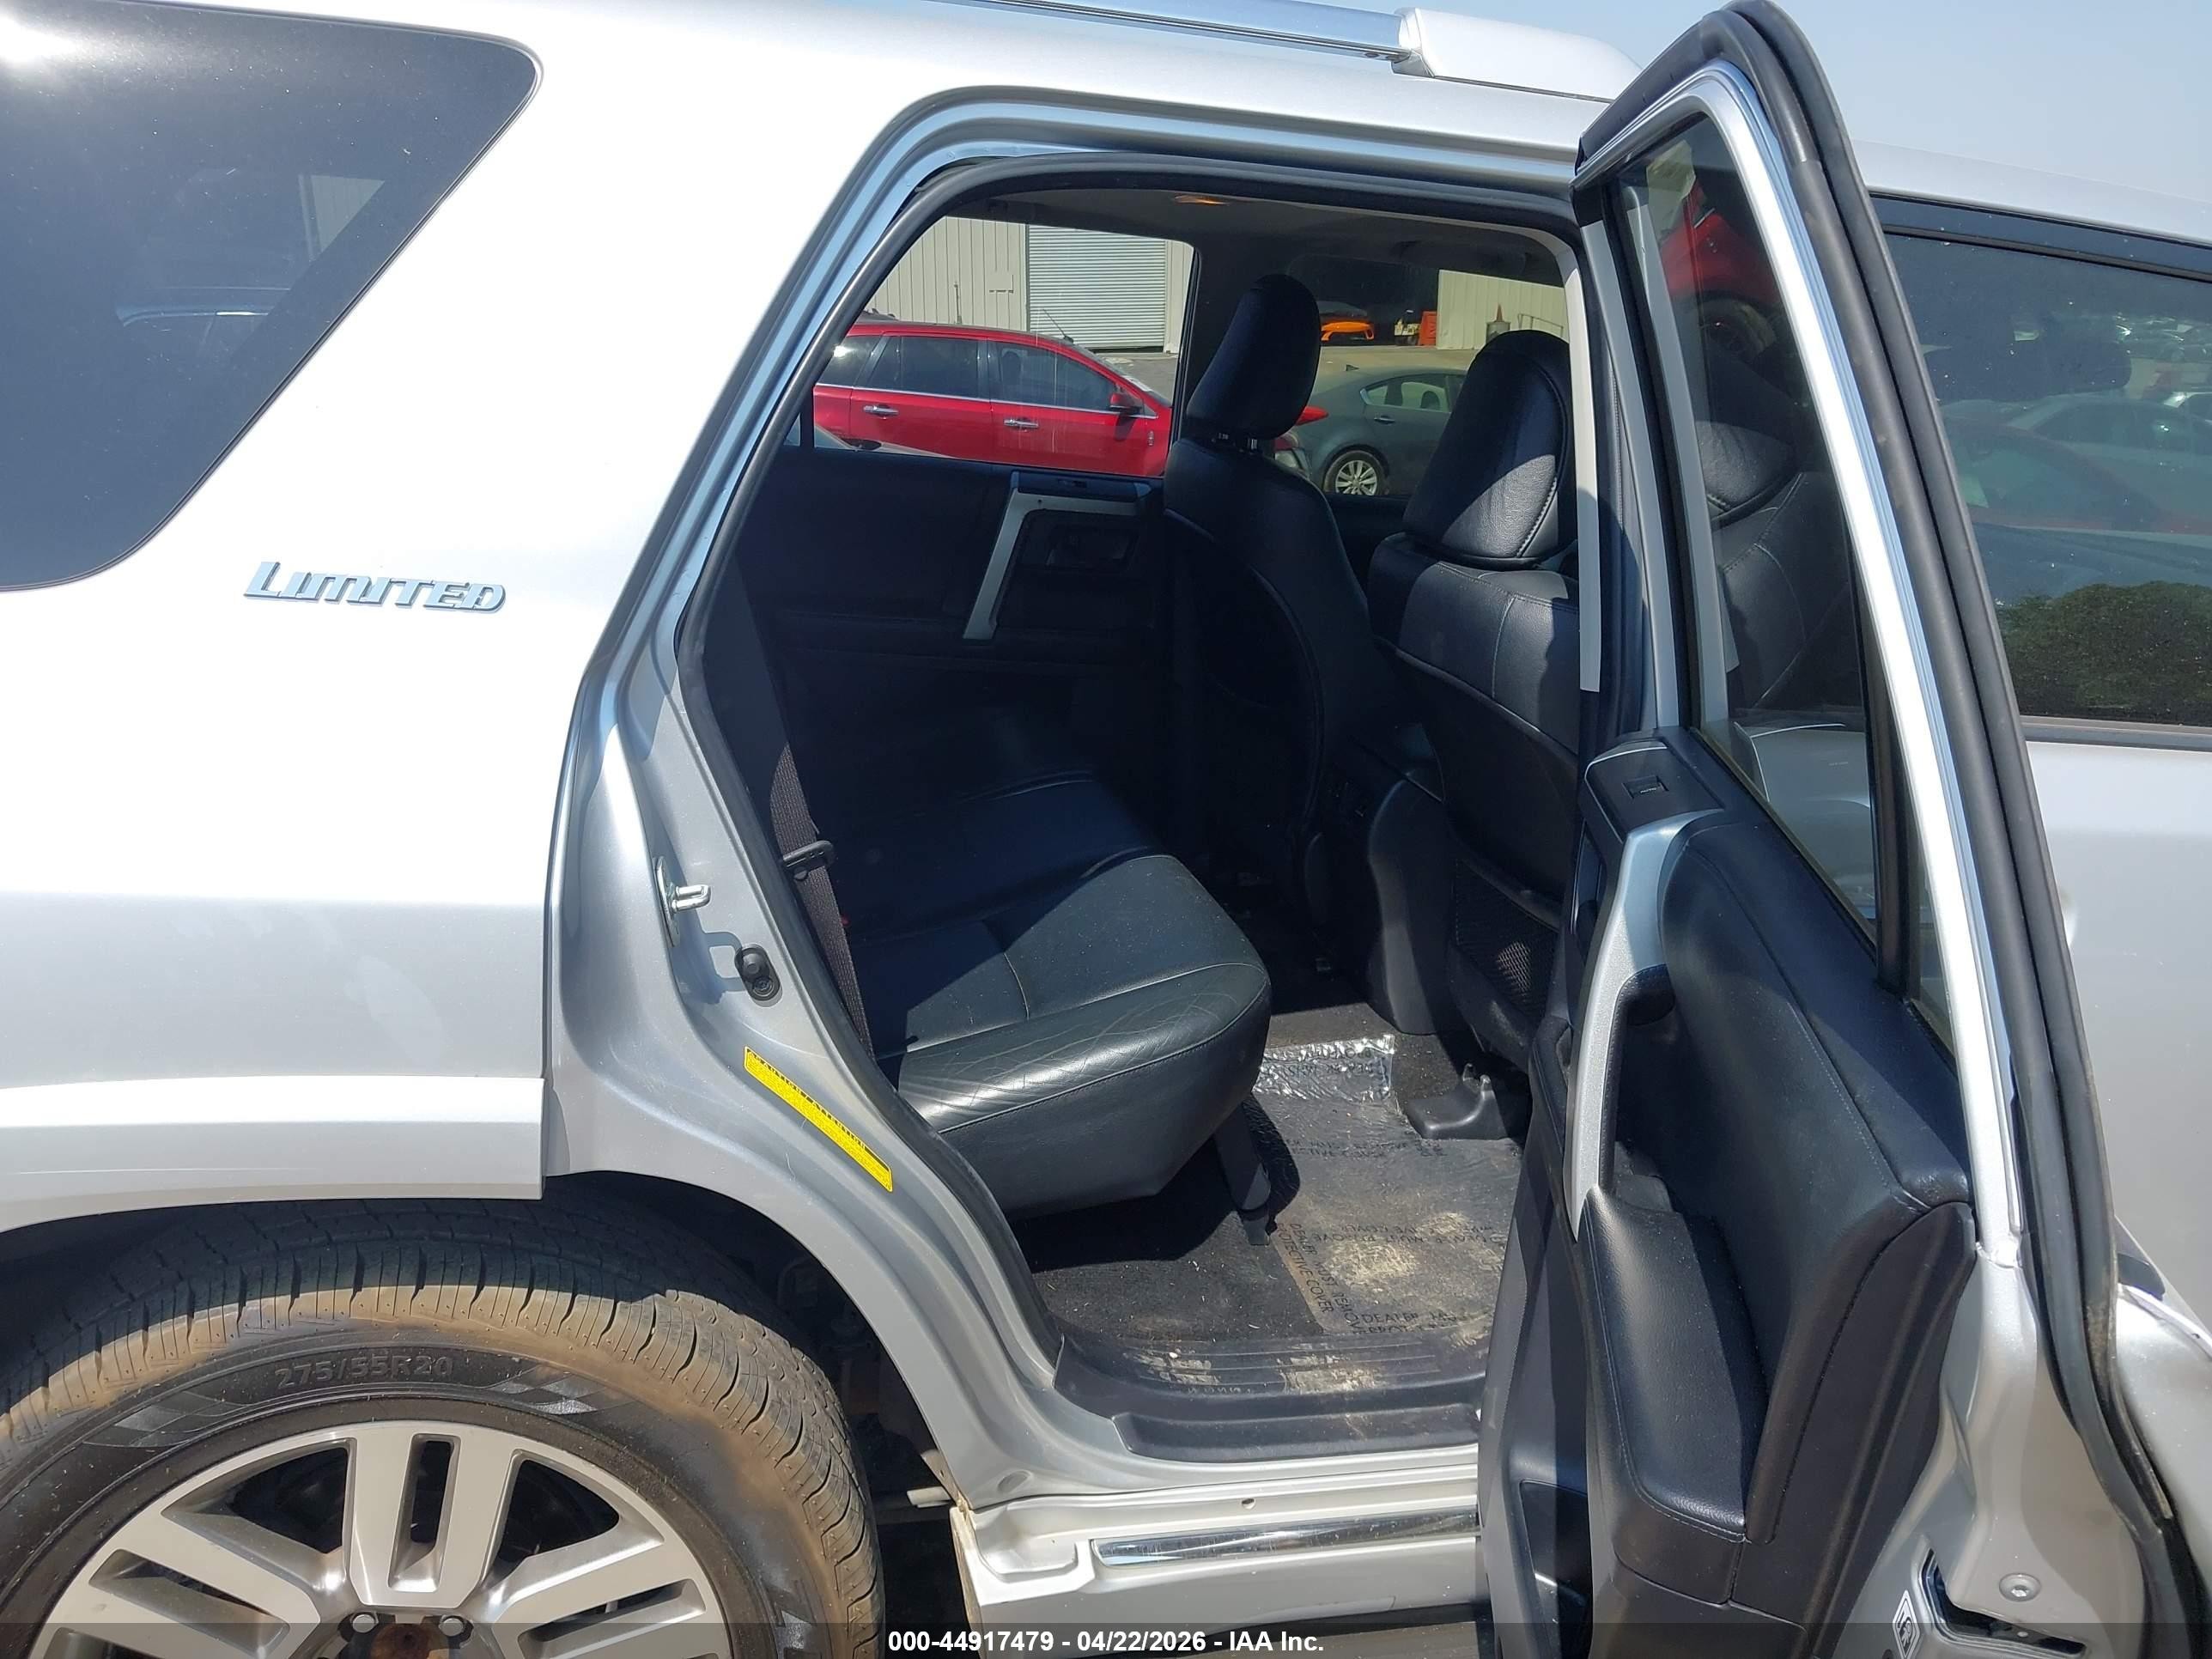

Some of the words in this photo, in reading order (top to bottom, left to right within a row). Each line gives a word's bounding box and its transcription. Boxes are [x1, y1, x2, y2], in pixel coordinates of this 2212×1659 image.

[244, 562, 507, 613] LIMITED
[1306, 1279, 1334, 1314] COVER
[274, 1355, 453, 1389] 275/55R20
